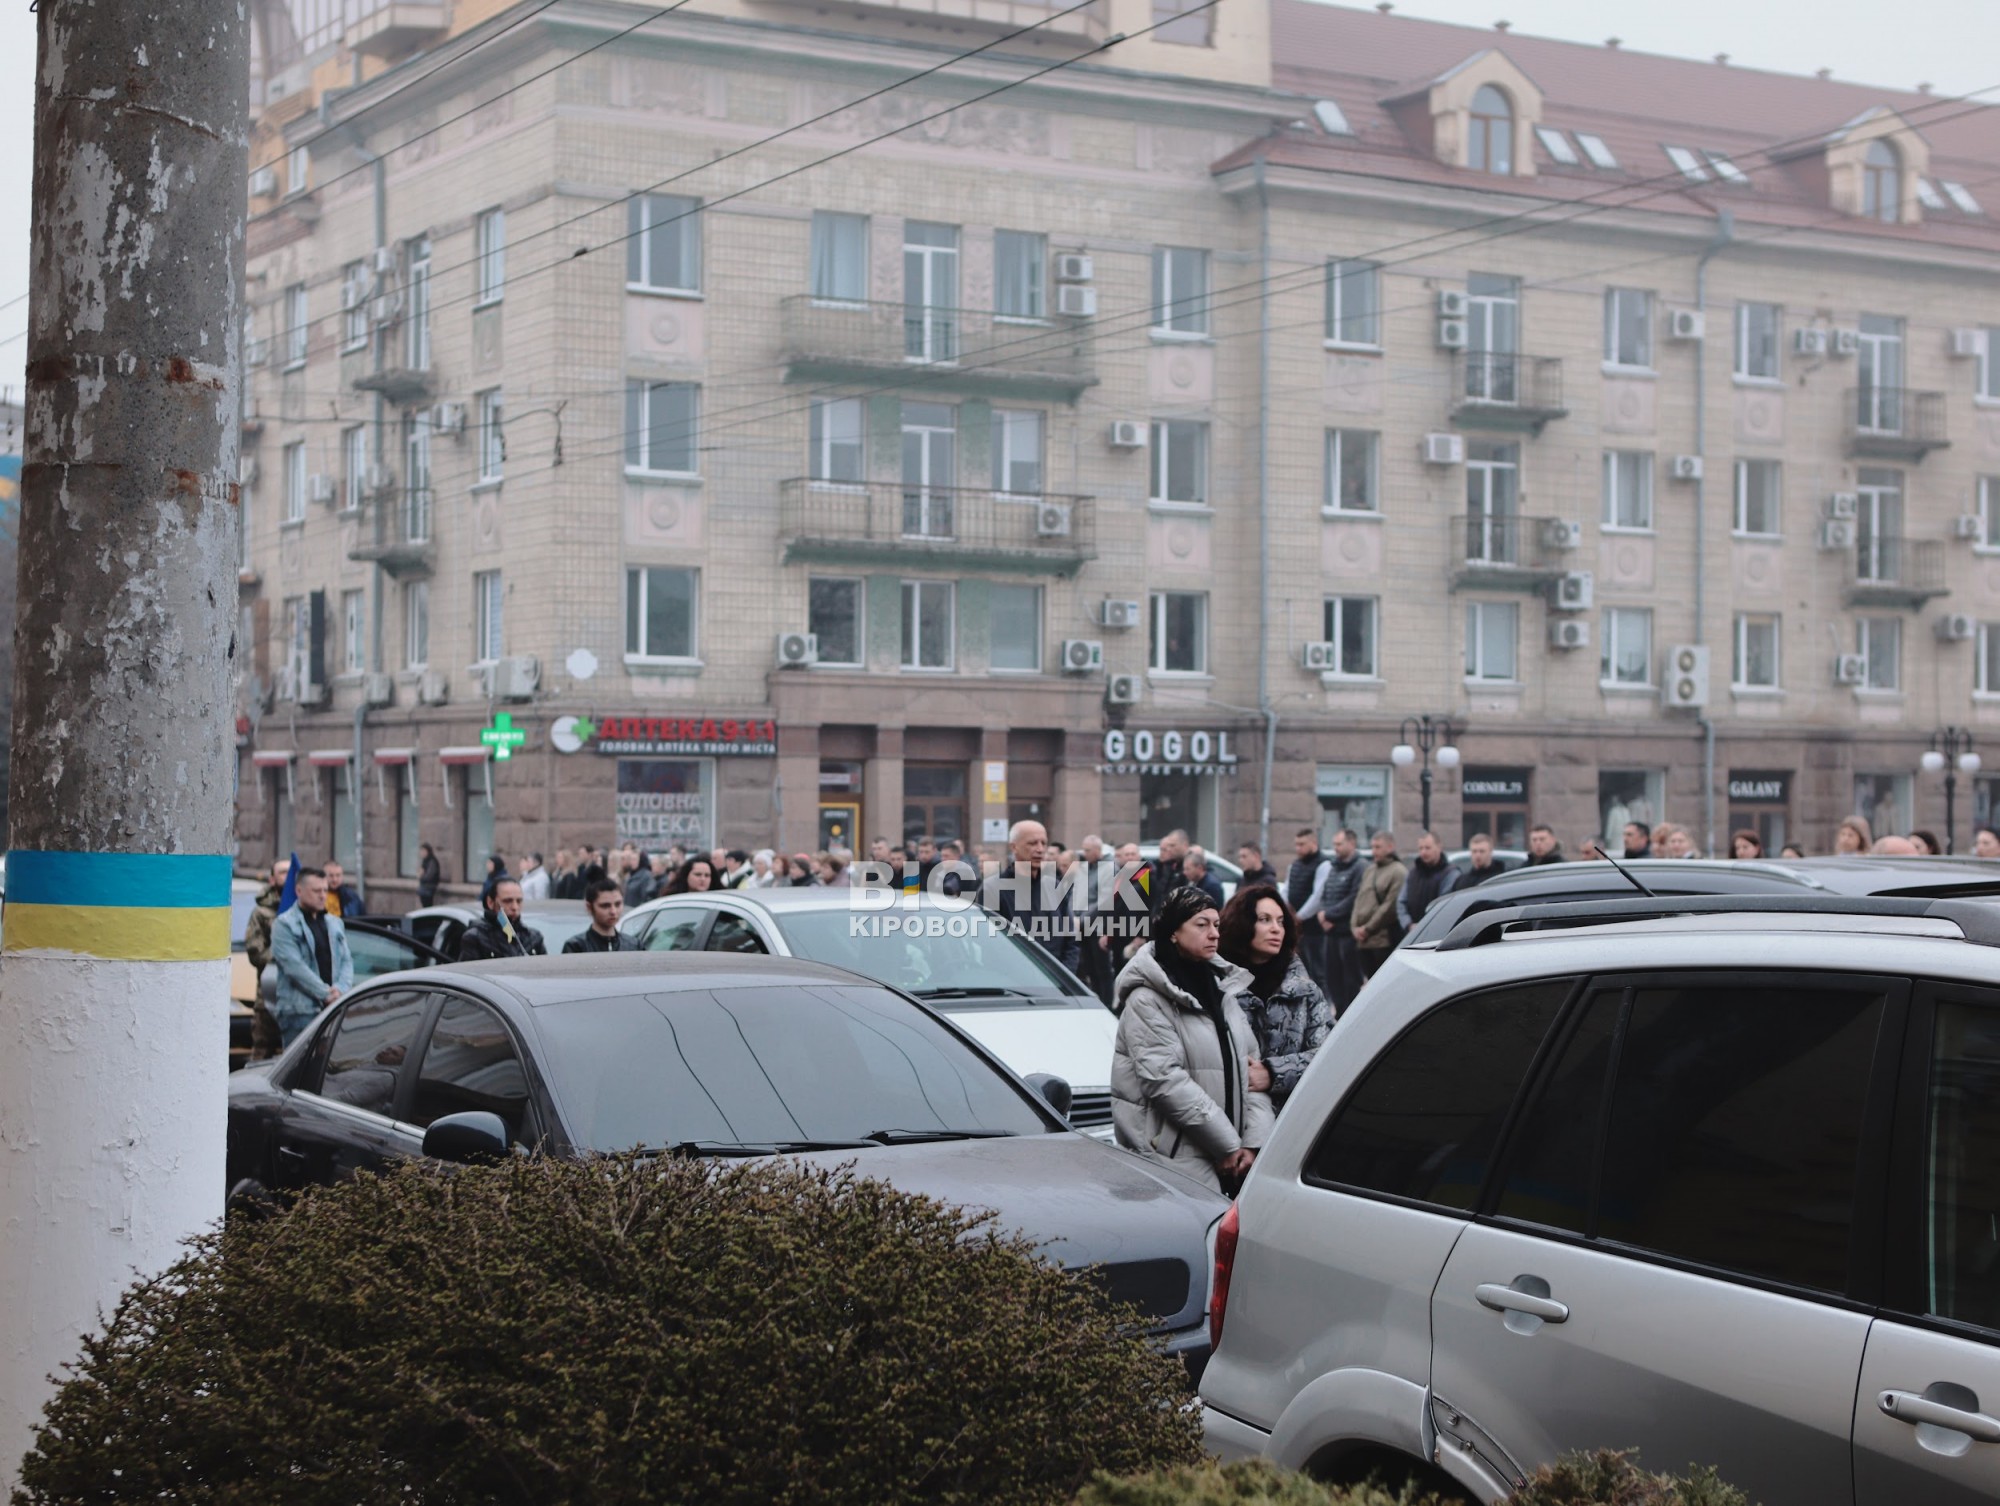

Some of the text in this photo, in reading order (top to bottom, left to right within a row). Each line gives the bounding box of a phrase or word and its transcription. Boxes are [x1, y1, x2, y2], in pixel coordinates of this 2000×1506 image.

[600, 717, 719, 740] АПТЕКА
[600, 741, 777, 754] ГОЛОВНА АПТЕКА ТВОГО МІСТА
[1105, 729, 1238, 763] GOGOL
[1104, 764, 1238, 776] COFFEE SPACE
[1730, 780, 1783, 798] GALANT
